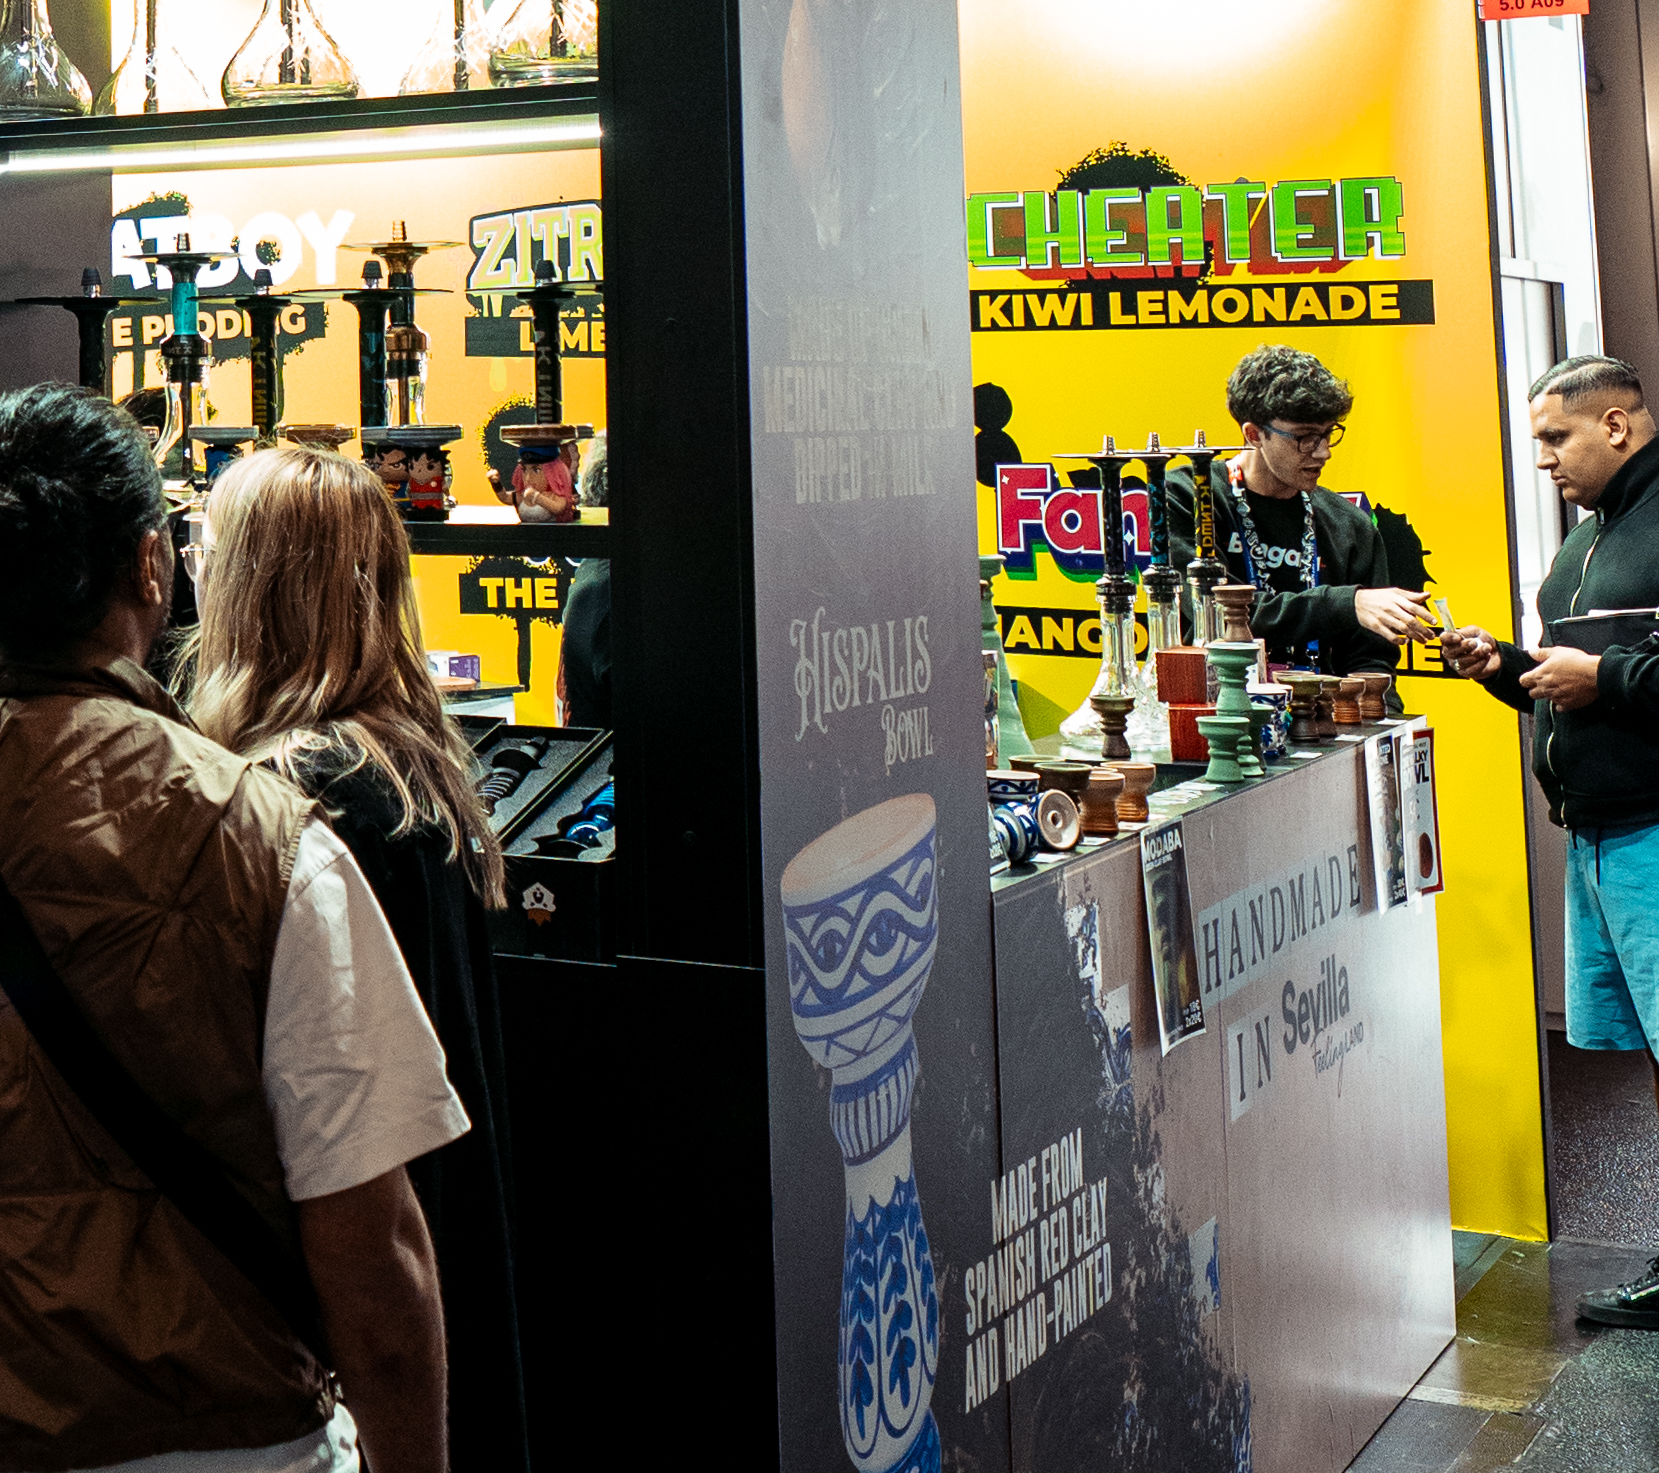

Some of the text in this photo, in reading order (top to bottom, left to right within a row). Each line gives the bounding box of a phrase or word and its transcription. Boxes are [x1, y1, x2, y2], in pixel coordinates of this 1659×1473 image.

[111, 209, 356, 290] ATBOY
[470, 203, 604, 289] ZITR
[966, 176, 1406, 269] CHEATER
[520, 320, 606, 352] LME
[978, 283, 1402, 329] KIWI LEMONADE
[479, 577, 559, 609] THE
[1003, 614, 1148, 655] ANGO
[789, 607, 933, 742] HISPALIS
[881, 703, 934, 776] BOWL
[1143, 828, 1183, 863] MODABA
[1202, 843, 1362, 995] HANDMADE
[1282, 954, 1350, 1055] Sevilla
[1236, 1015, 1272, 1102] IN
[991, 1127, 1084, 1245] MADE FROM
[965, 1176, 1108, 1336] SPANISH RED CLAY
[965, 1242, 1113, 1415] AND HAND-PAINTED
